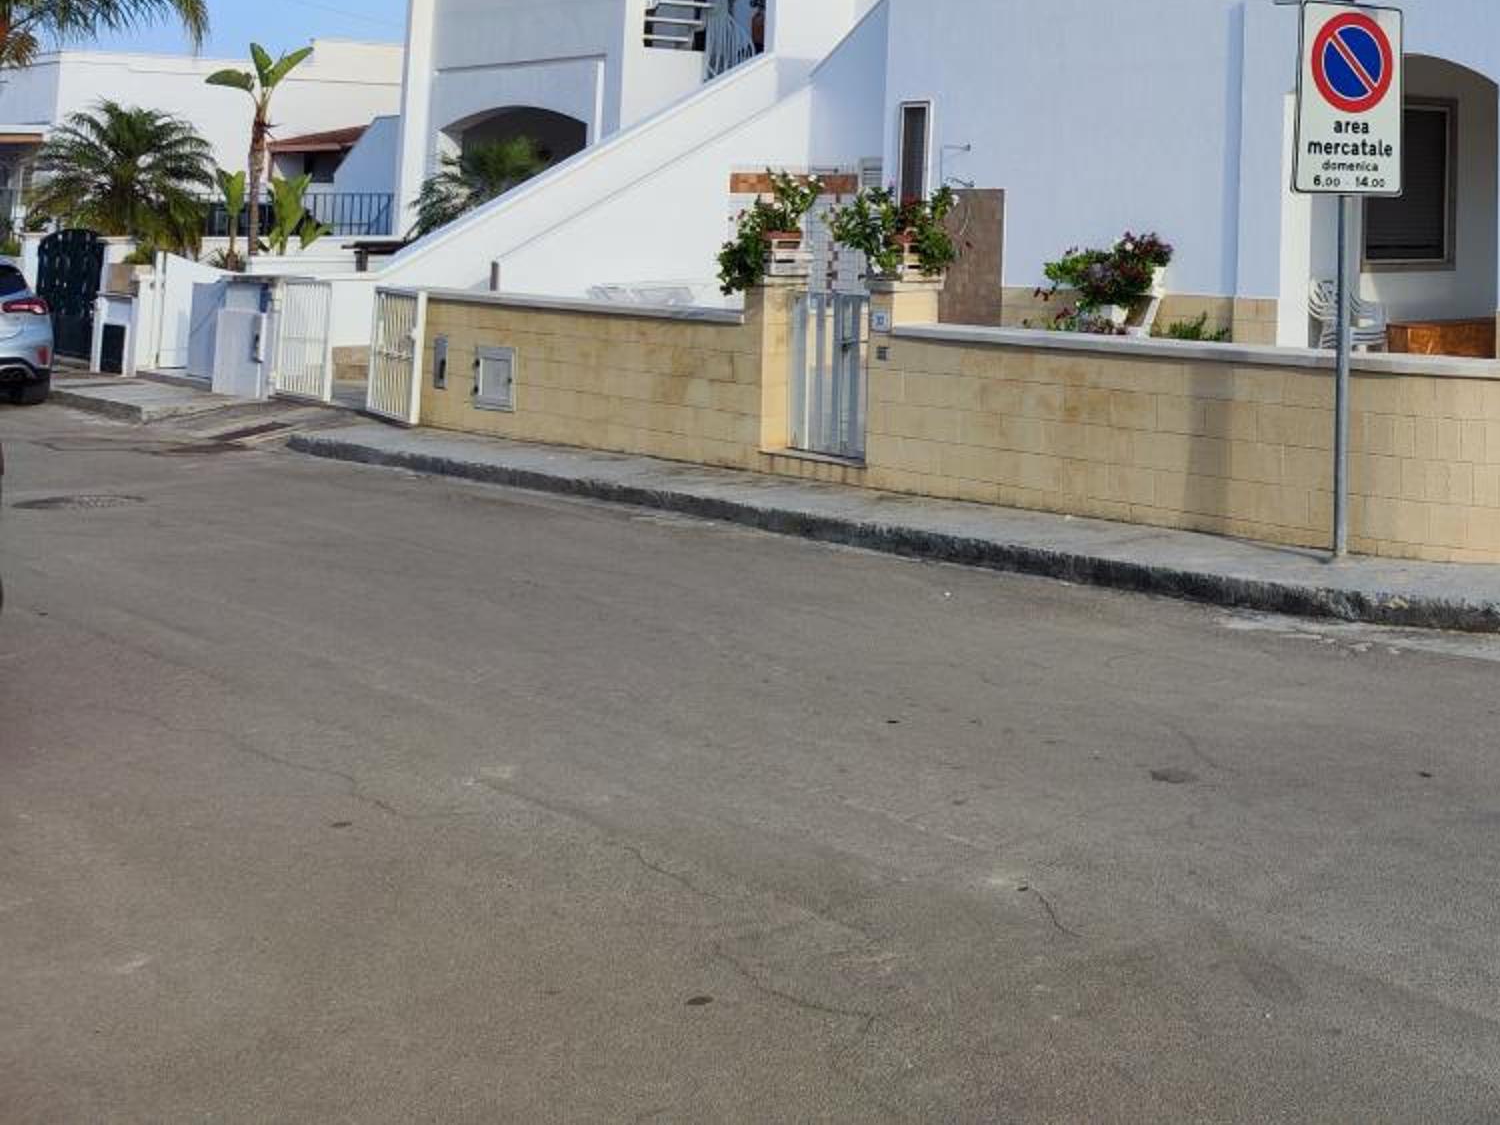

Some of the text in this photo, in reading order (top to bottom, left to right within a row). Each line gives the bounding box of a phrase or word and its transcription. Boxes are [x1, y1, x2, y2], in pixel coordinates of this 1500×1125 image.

[1333, 120, 1370, 134] area
[1307, 138, 1393, 157] mercatale
[1321, 159, 1379, 172] domenica
[1313, 175, 1341, 187] 6.00
[1355, 176, 1386, 188] 14.00
